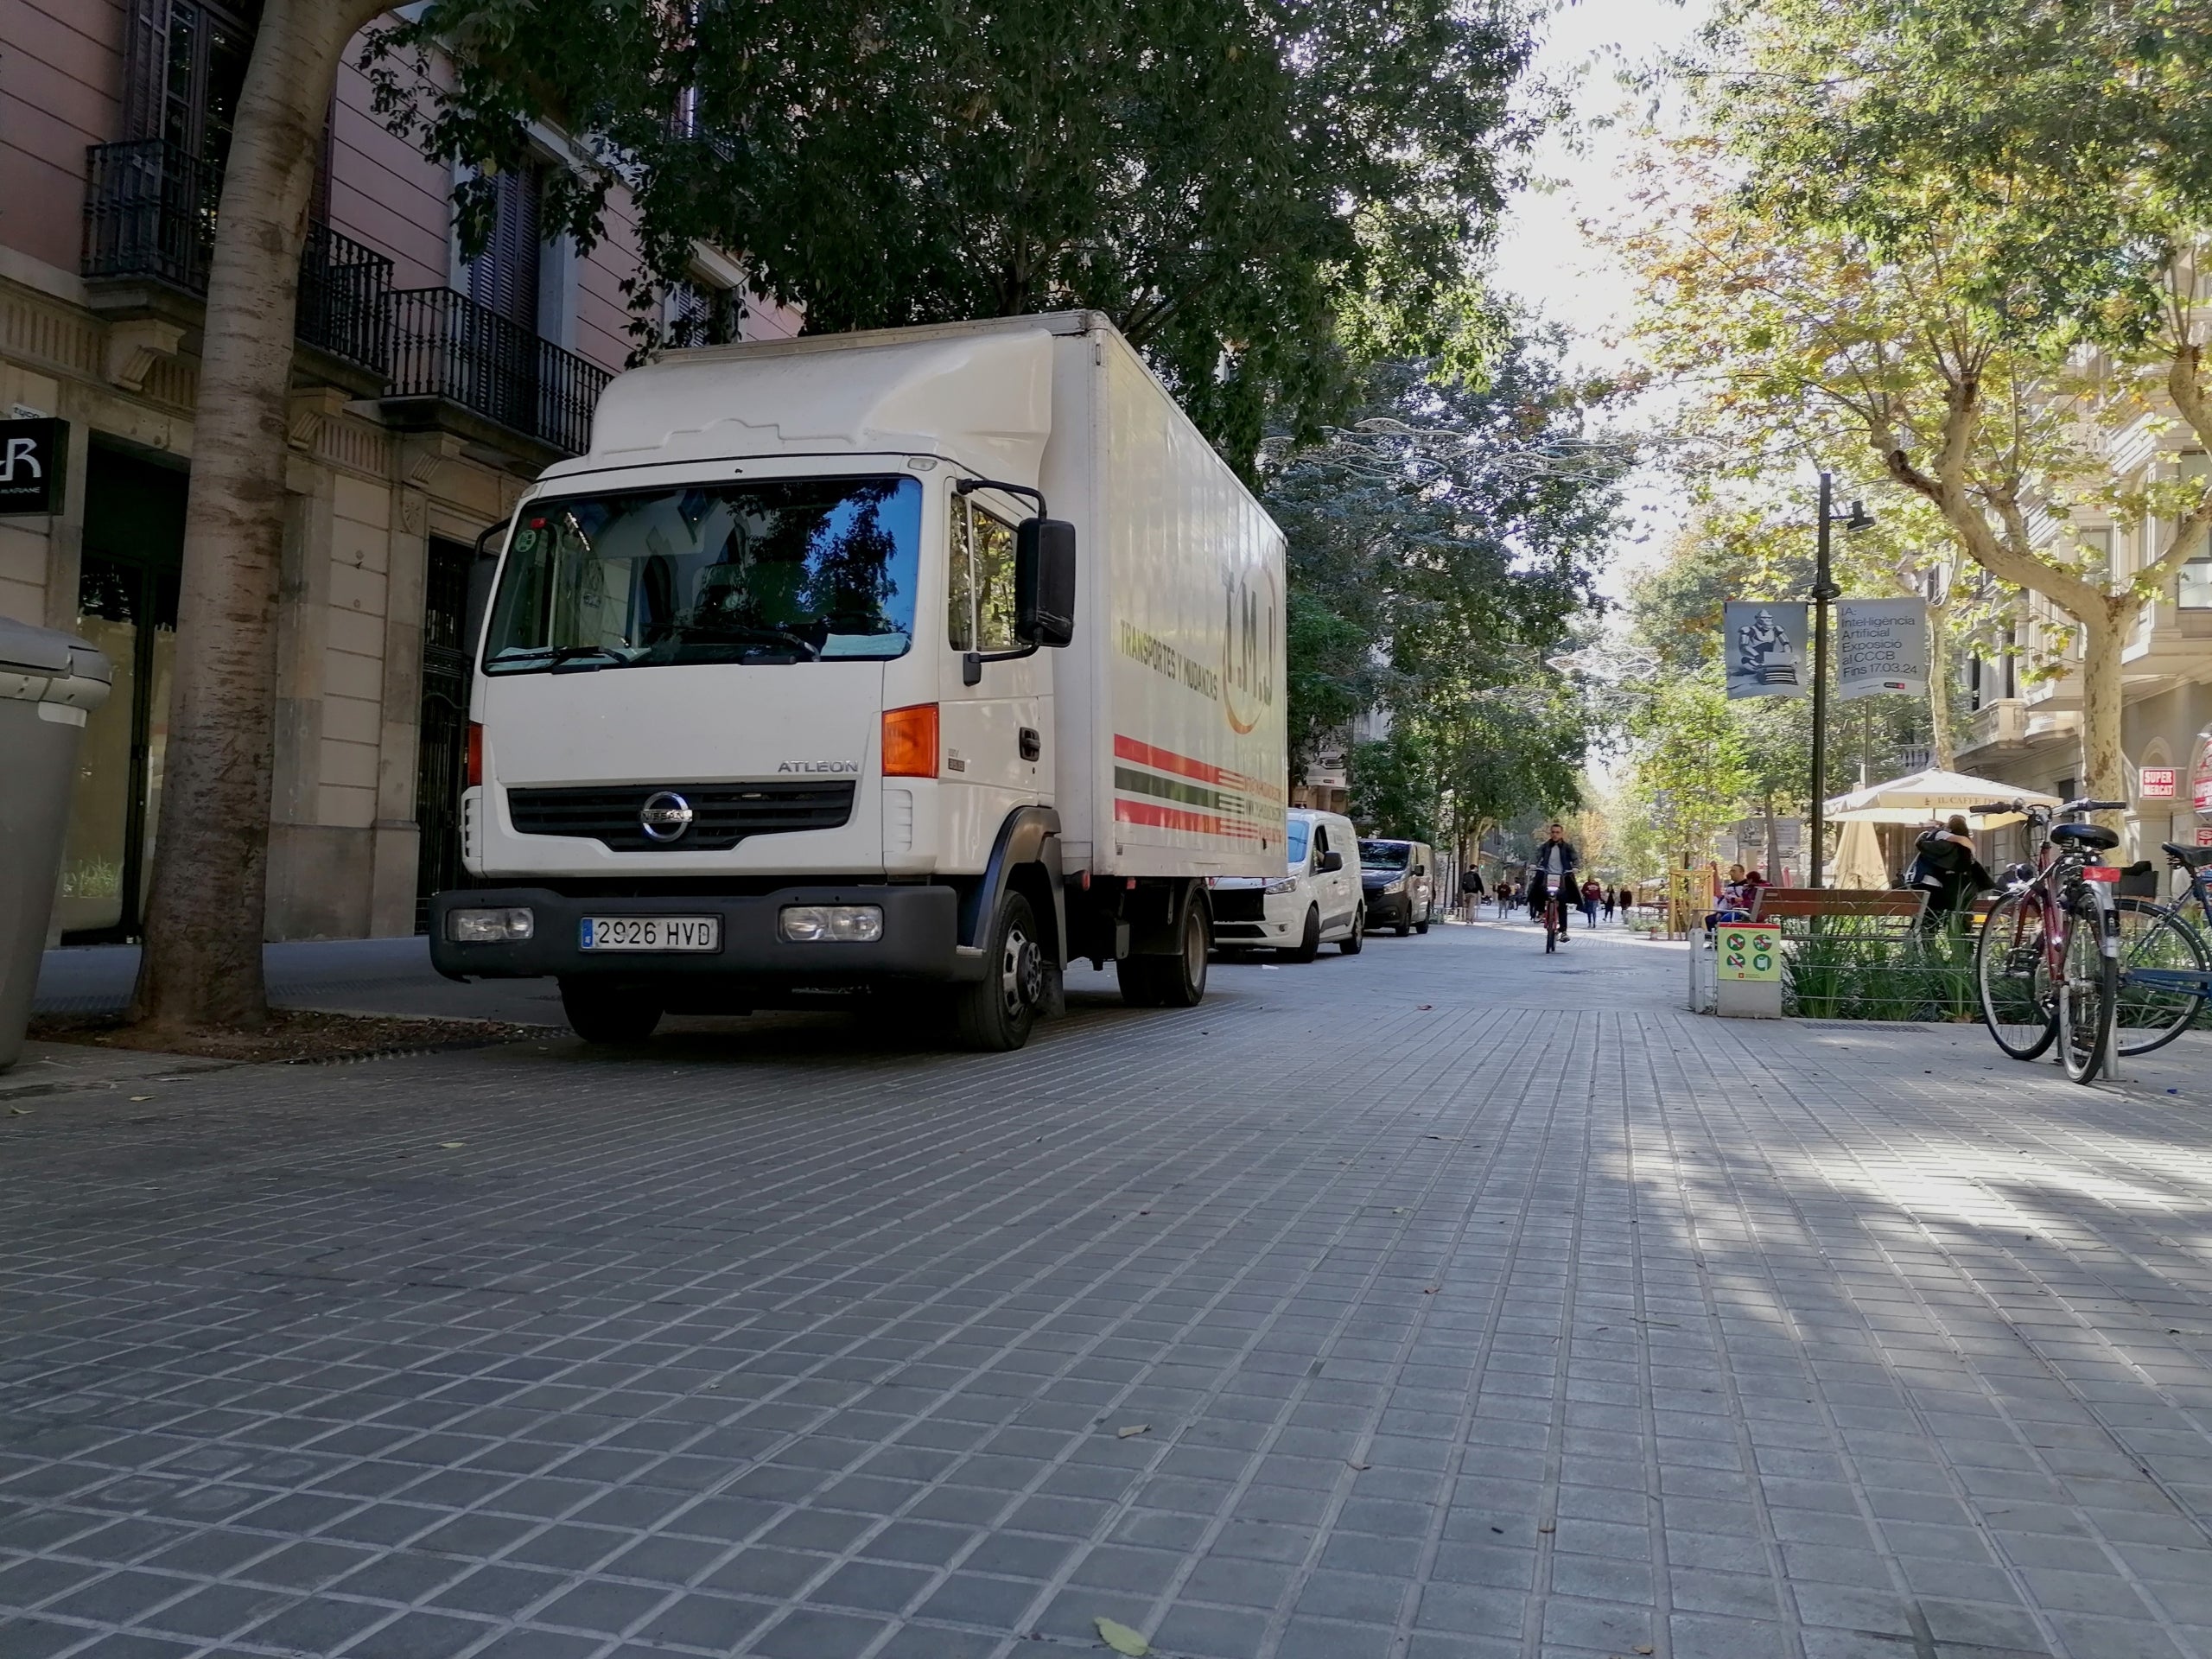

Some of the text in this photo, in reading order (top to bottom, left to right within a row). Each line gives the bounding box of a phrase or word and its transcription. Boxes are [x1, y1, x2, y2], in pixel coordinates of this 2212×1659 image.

[1841, 628, 1890, 640] Artificial
[1842, 639, 1902, 652] Exposició
[1120, 619, 1217, 702] TRANSPORTES Y MUDANZAS
[1842, 651, 1896, 665] al CCCB
[1843, 663, 1917, 677] Fins 17.03.24
[778, 760, 858, 772] ATLEON
[2145, 771, 2172, 784] SUPER
[2144, 785, 2173, 795] MERCAT
[597, 921, 710, 945] 2926 HVD
